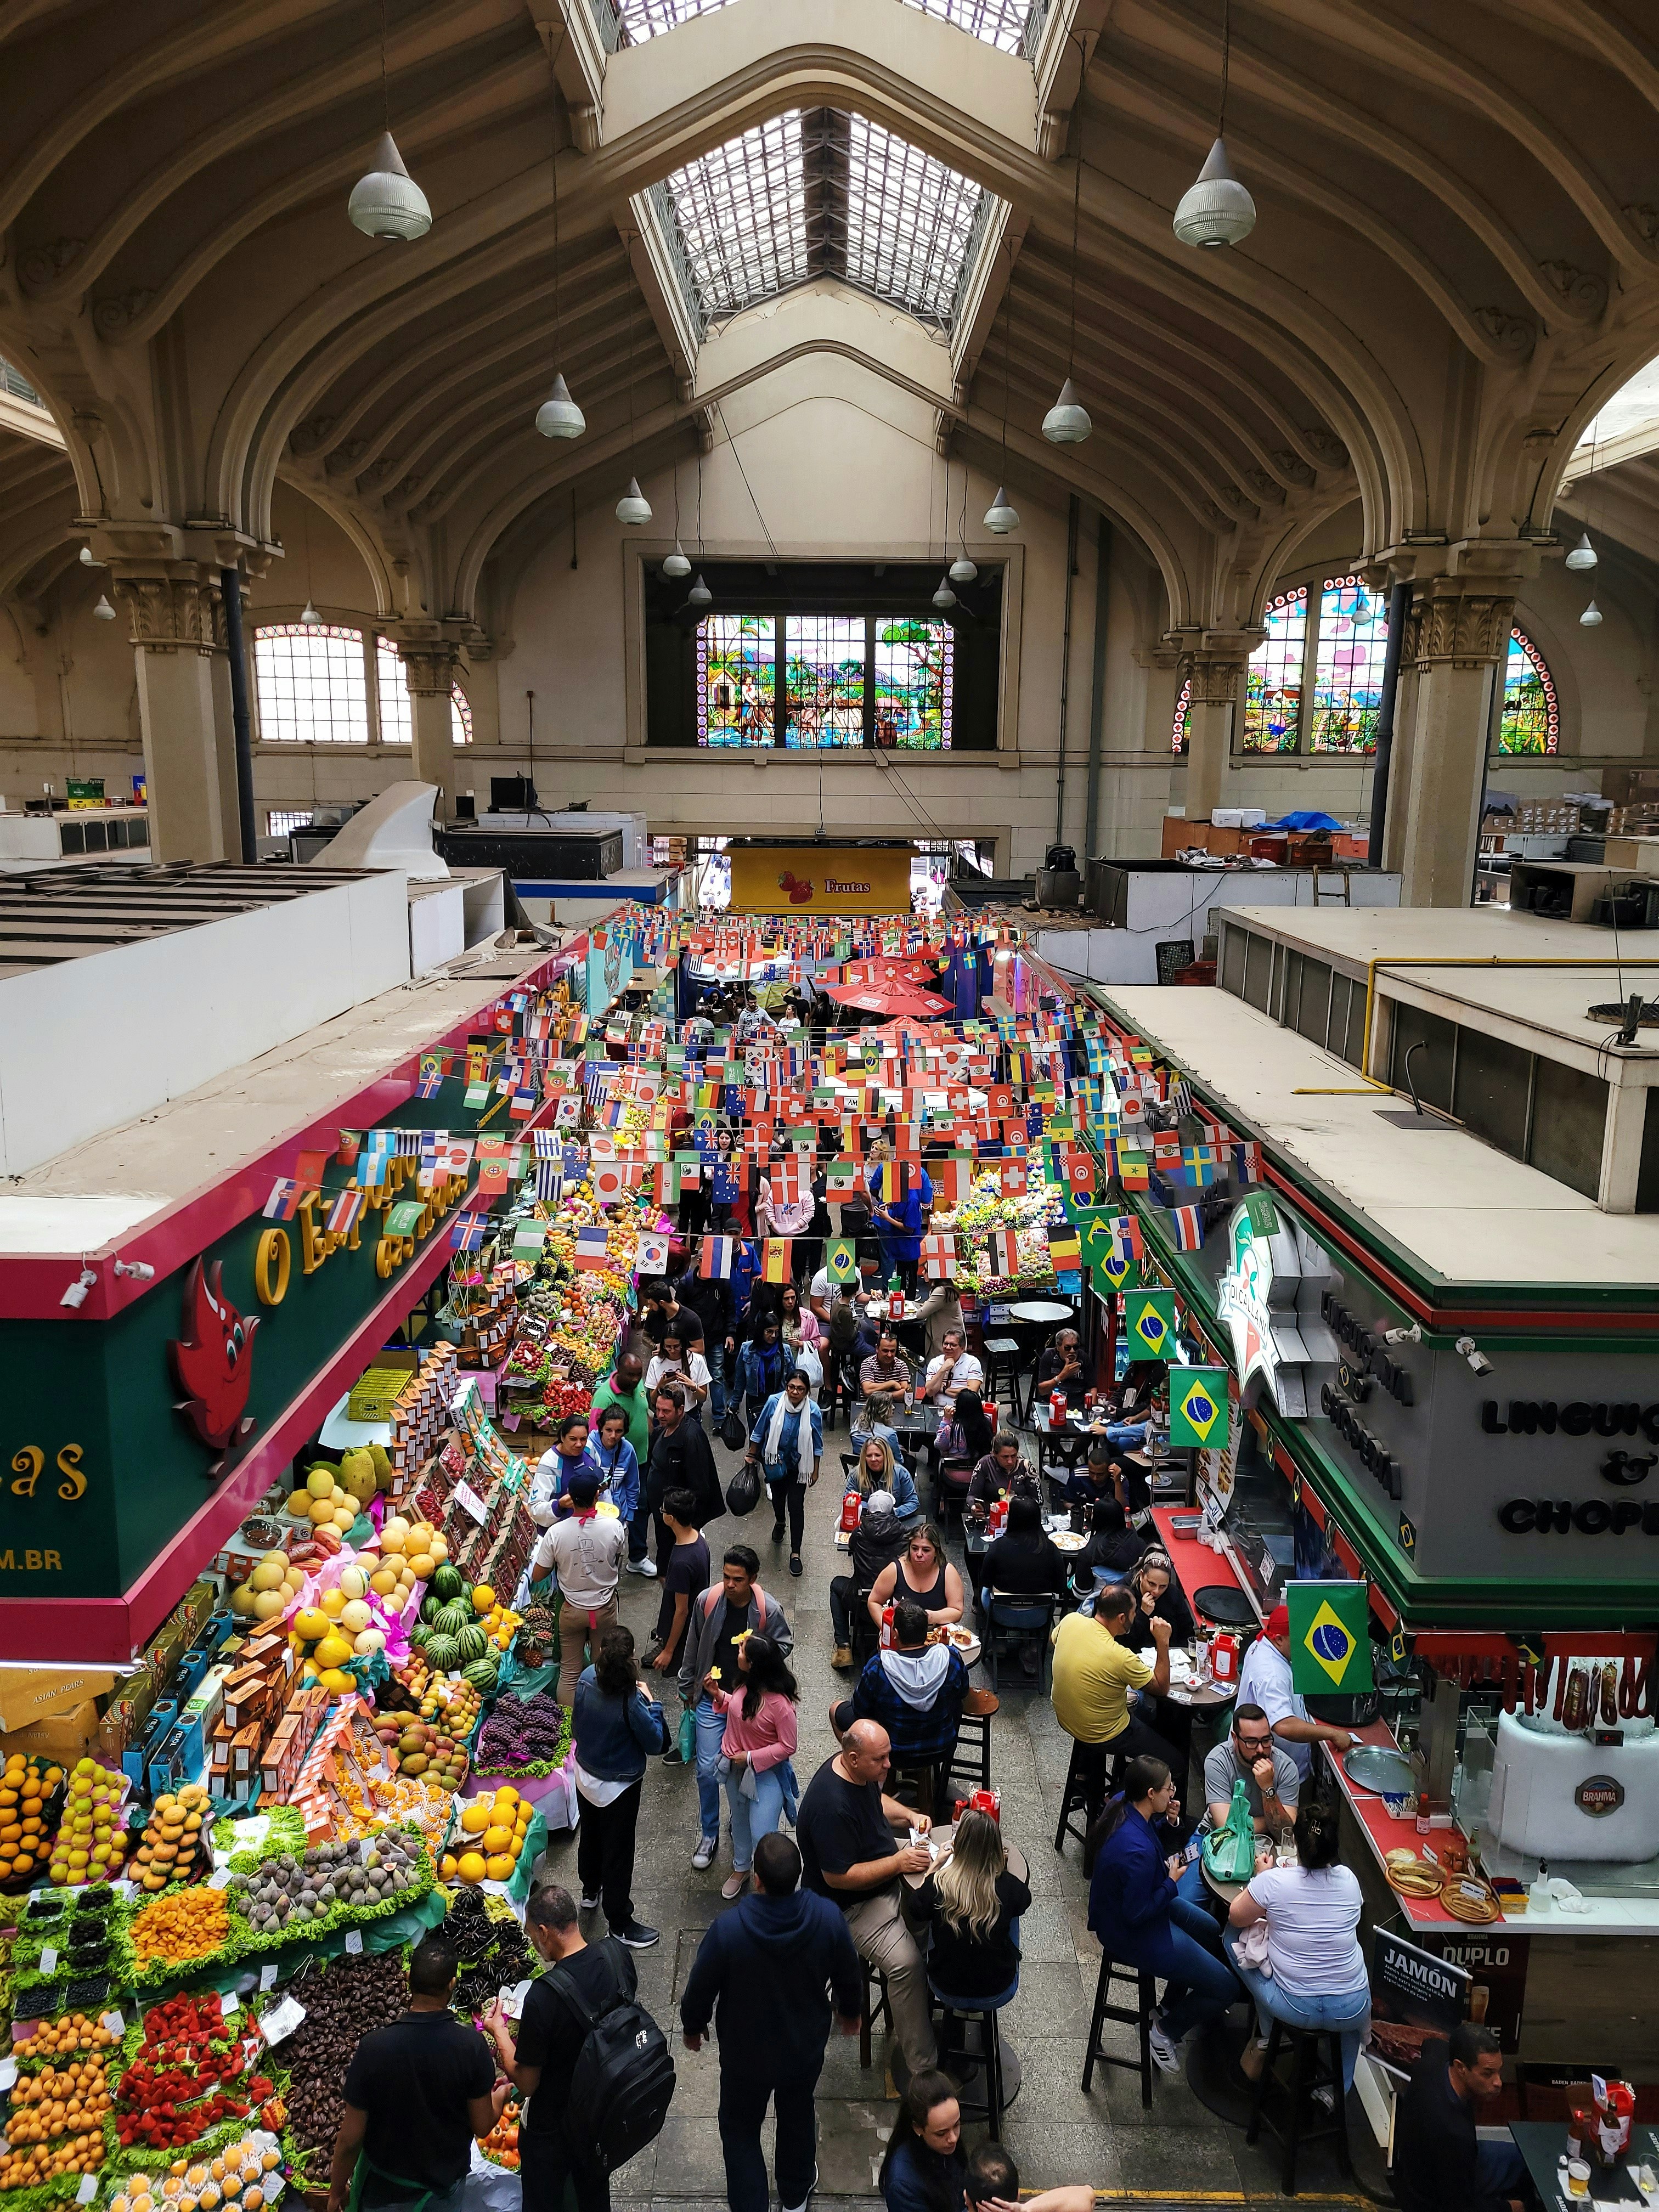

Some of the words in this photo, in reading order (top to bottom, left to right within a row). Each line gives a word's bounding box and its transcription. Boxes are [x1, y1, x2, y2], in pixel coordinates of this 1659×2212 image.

[825, 879, 871, 893] Frutas
[1231, 1284, 1238, 1301] DI
[1238, 1289, 1267, 1337] CALLANI
[1599, 1449, 1659, 1486] &
[33, 1688, 58, 1704] ASIAN
[60, 1678, 84, 1694] PEARS
[1583, 1791, 1616, 1802] BRAHMA
[1442, 1946, 1510, 1966] DUPLO
[1384, 1948, 1458, 1999] JAMÓN
[1400, 1973, 1410, 1982] com
[1410, 1978, 1426, 1989] molho
